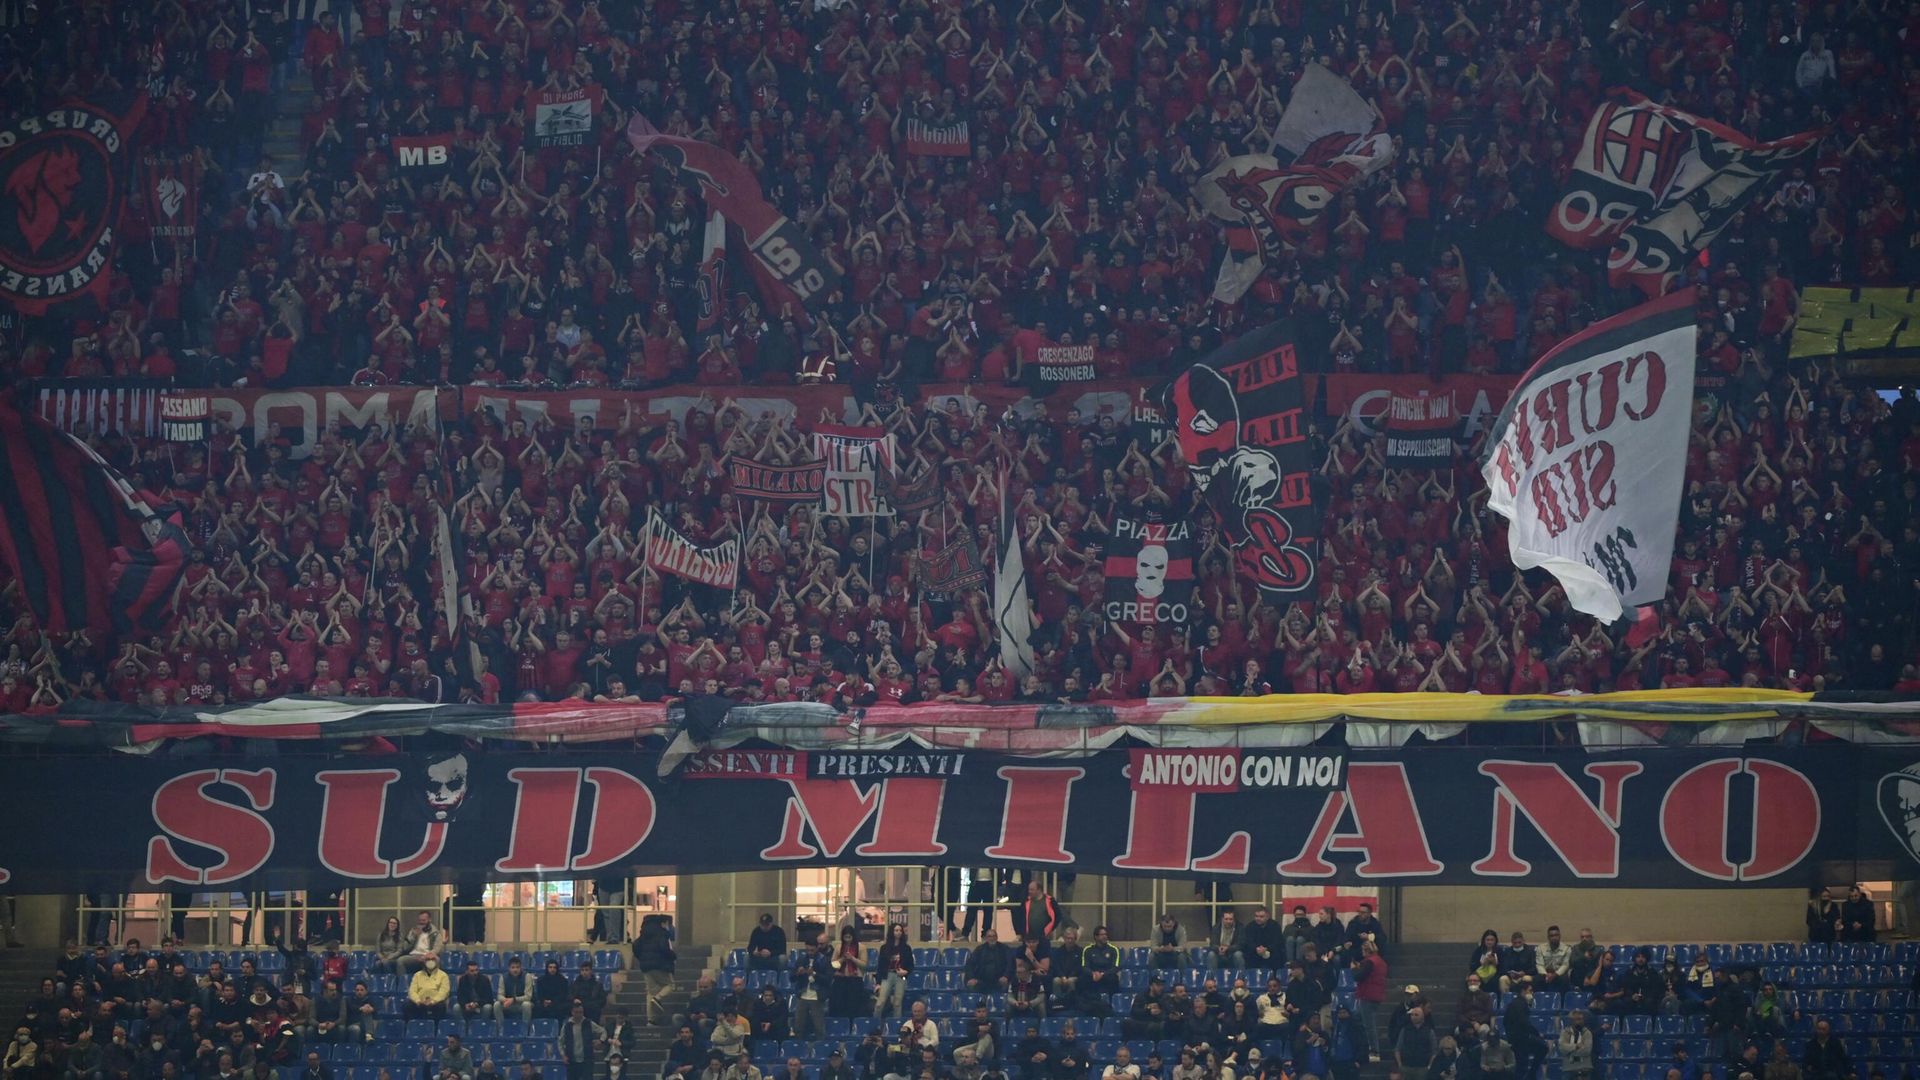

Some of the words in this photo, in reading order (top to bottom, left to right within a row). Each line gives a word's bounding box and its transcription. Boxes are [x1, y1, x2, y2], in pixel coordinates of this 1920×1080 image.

[400, 145, 448, 167] MB
[1037, 345, 1095, 363] CRESCENZAGO
[1039, 366, 1096, 381] ROSSONERA
[40, 387, 166, 439] TRANSENN
[160, 396, 208, 417] ASSANO
[1429, 395, 1450, 420] NON
[817, 434, 893, 474] MILAN
[734, 467, 823, 491] MILANO
[1115, 518, 1190, 541] PIAZZA
[1106, 601, 1188, 623] GRECO
[816, 753, 966, 776] PRESENTI
[1139, 754, 1237, 787] ANTONIO
[1241, 756, 1292, 787] CON
[1297, 755, 1343, 787] NOI
[145, 765, 657, 885] SUD
[760, 757, 1823, 882] MILANO
